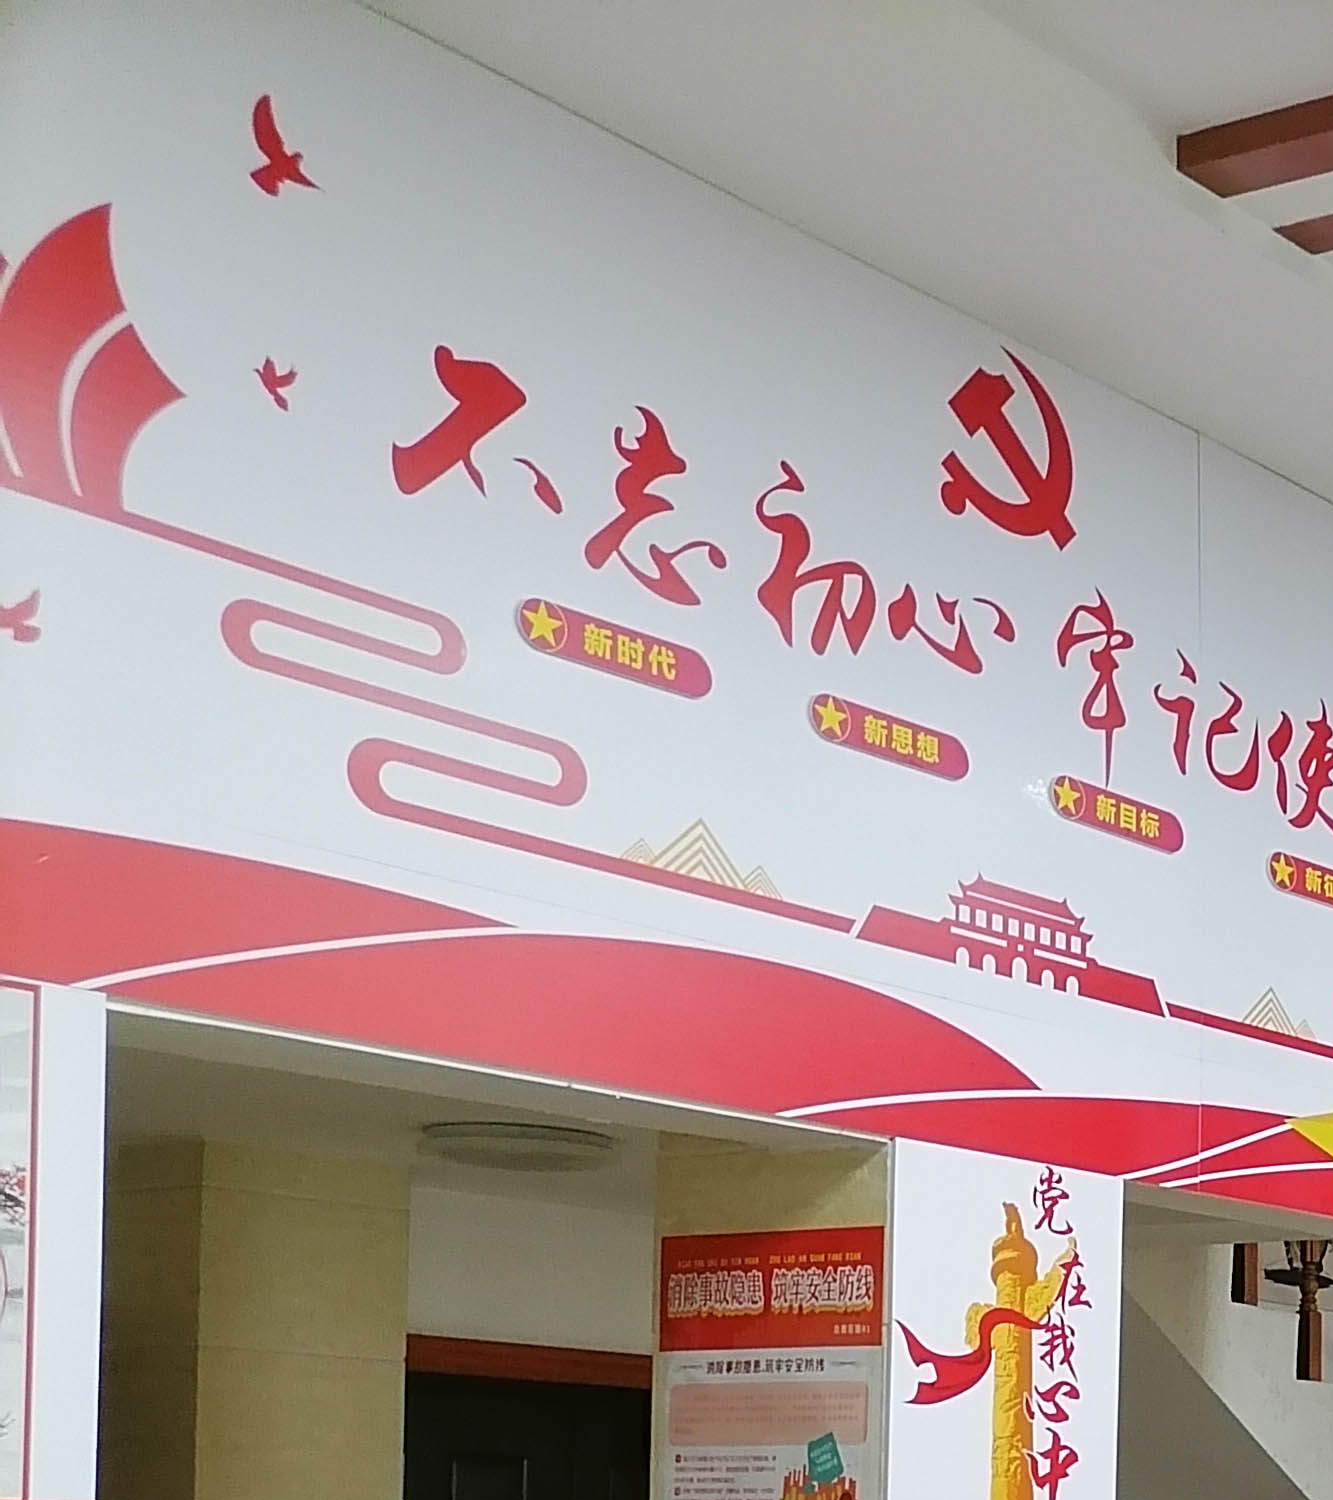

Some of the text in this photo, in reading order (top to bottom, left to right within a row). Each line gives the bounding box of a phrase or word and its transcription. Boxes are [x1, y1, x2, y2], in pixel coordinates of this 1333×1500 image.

[583, 623, 677, 681] 新时代
[863, 714, 941, 765] 新思想
[1096, 794, 1161, 840] 新目标
[771, 1265, 874, 1311] 筑牢安全防线
